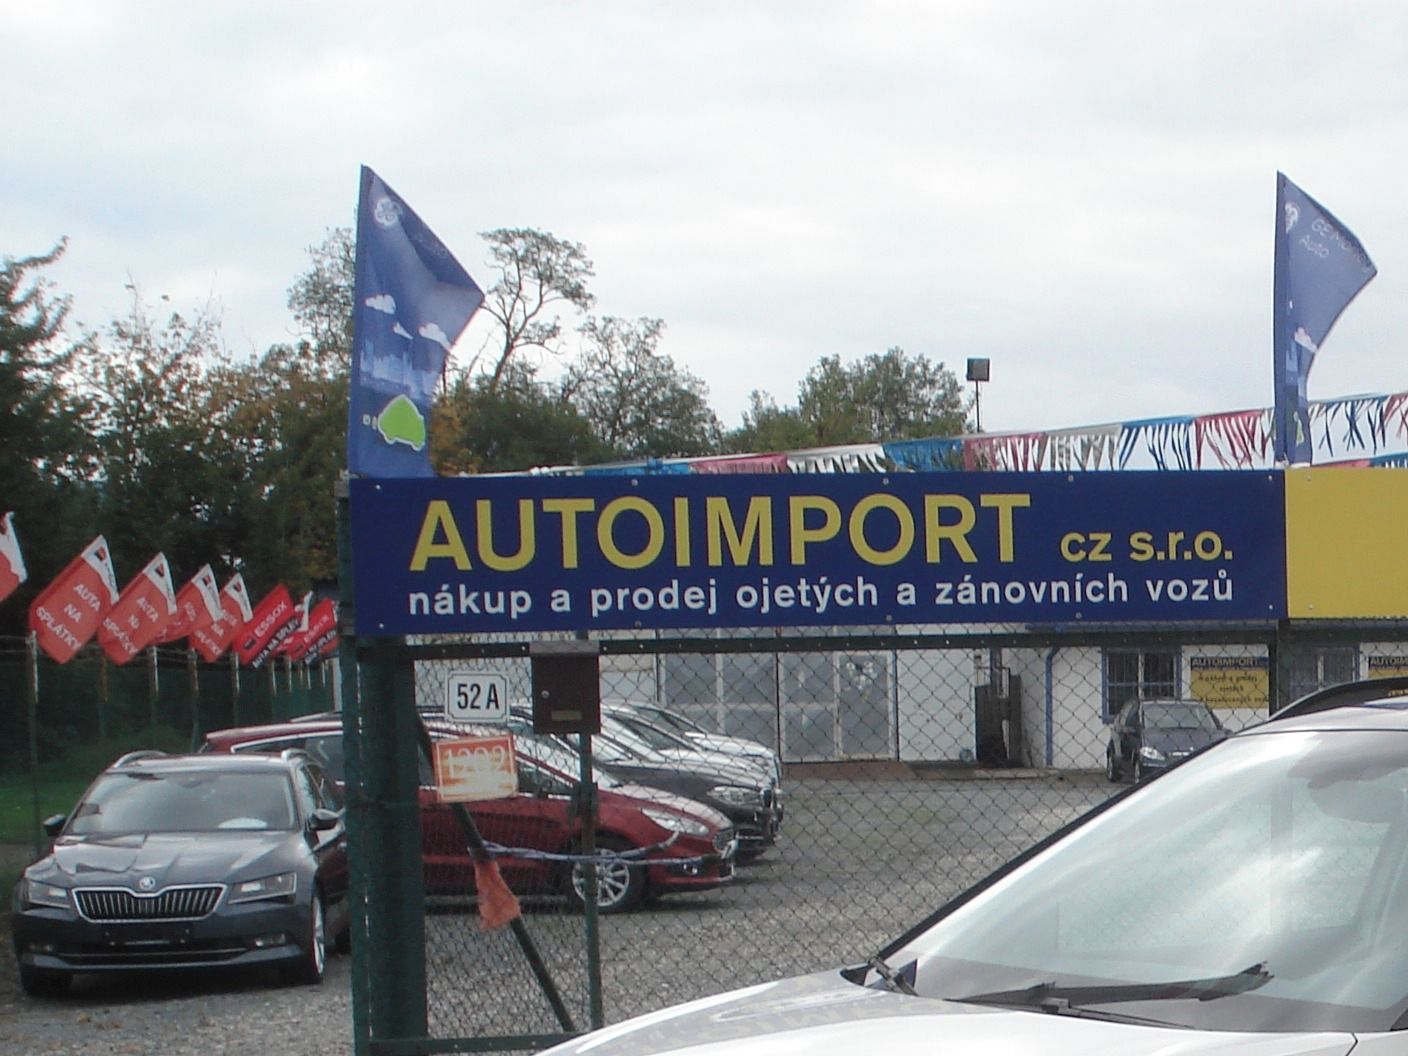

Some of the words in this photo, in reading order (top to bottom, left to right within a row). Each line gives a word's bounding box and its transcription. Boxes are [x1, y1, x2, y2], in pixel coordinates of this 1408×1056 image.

[409, 493, 1031, 572] AUTOIMPORT
[1060, 531, 1112, 562] cz
[1129, 530, 1234, 561] s.r.o.
[64, 603, 82, 623] NA
[73, 584, 101, 612] AUTA
[409, 584, 533, 620] nákup
[551, 587, 571, 613] a
[591, 579, 717, 618] prodej
[736, 576, 878, 614] ojetých
[897, 581, 916, 606] a
[935, 573, 1128, 606] zánovních
[1146, 569, 1233, 601] vozů
[36, 606, 82, 650] SPLÁTKY
[254, 601, 287, 637] ESSOX
